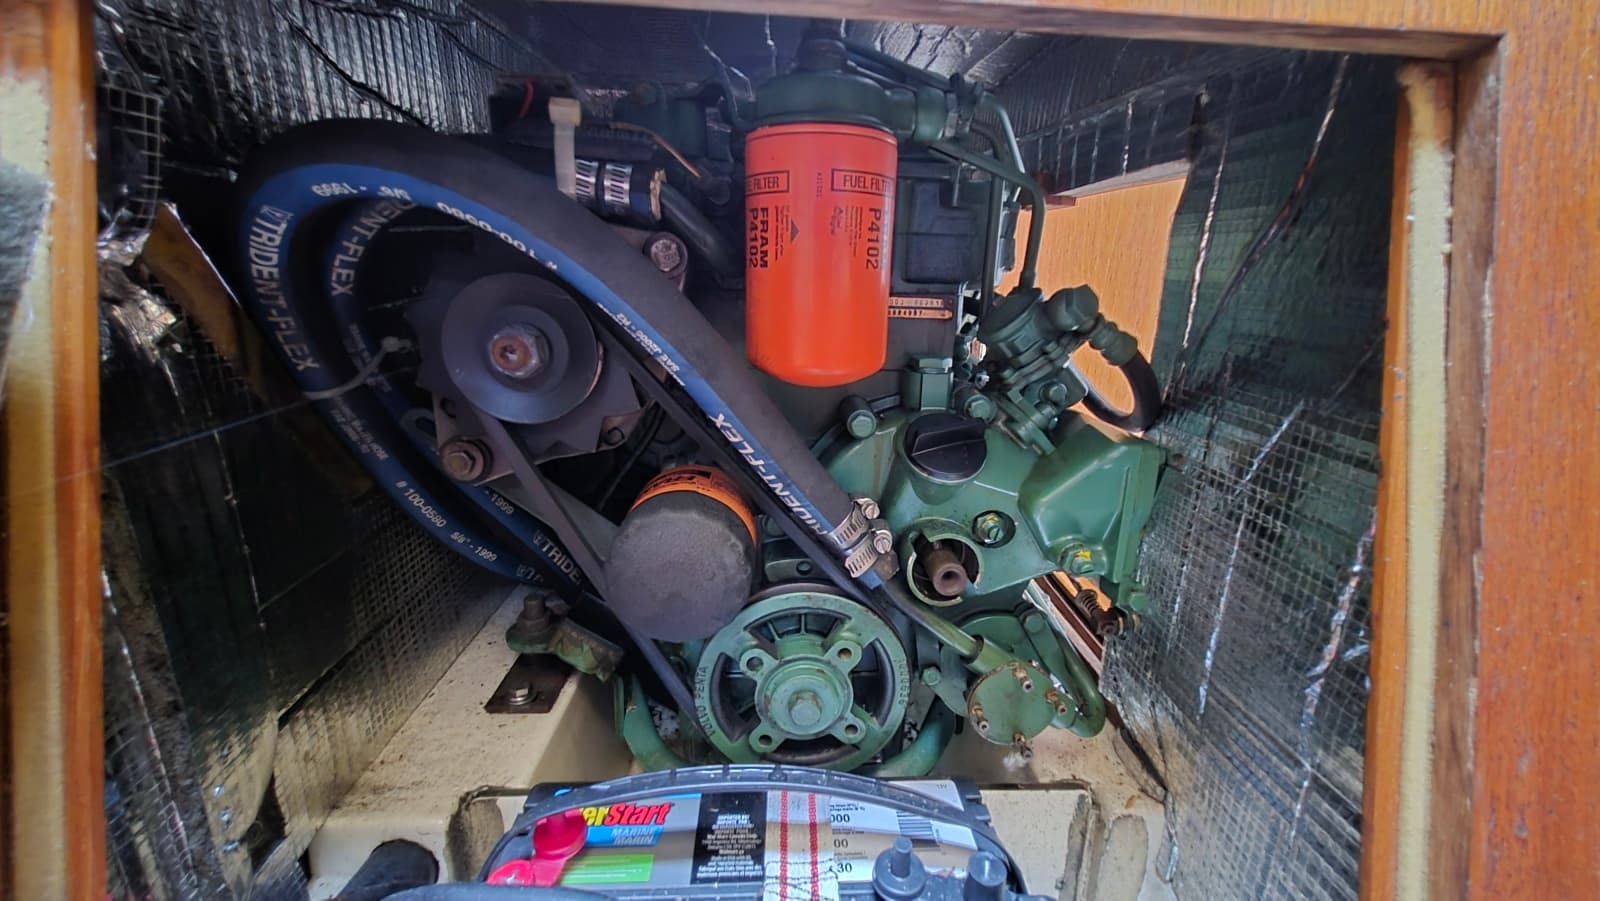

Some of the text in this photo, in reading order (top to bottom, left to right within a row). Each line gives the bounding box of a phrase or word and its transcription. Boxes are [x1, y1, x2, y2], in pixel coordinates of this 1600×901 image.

[843, 174, 869, 190] FUEL
[748, 207, 759, 269] P4102
[760, 207, 769, 269] FRAM
[865, 207, 882, 270] P4102
[249, 216, 321, 372] TRIDENT-FLEX
[404, 488, 447, 528] 100-0580
[475, 546, 498, 562] 1999
[491, 493, 514, 515] 1999
[580, 802, 672, 827] erStart
[614, 835, 653, 846] MARIN
